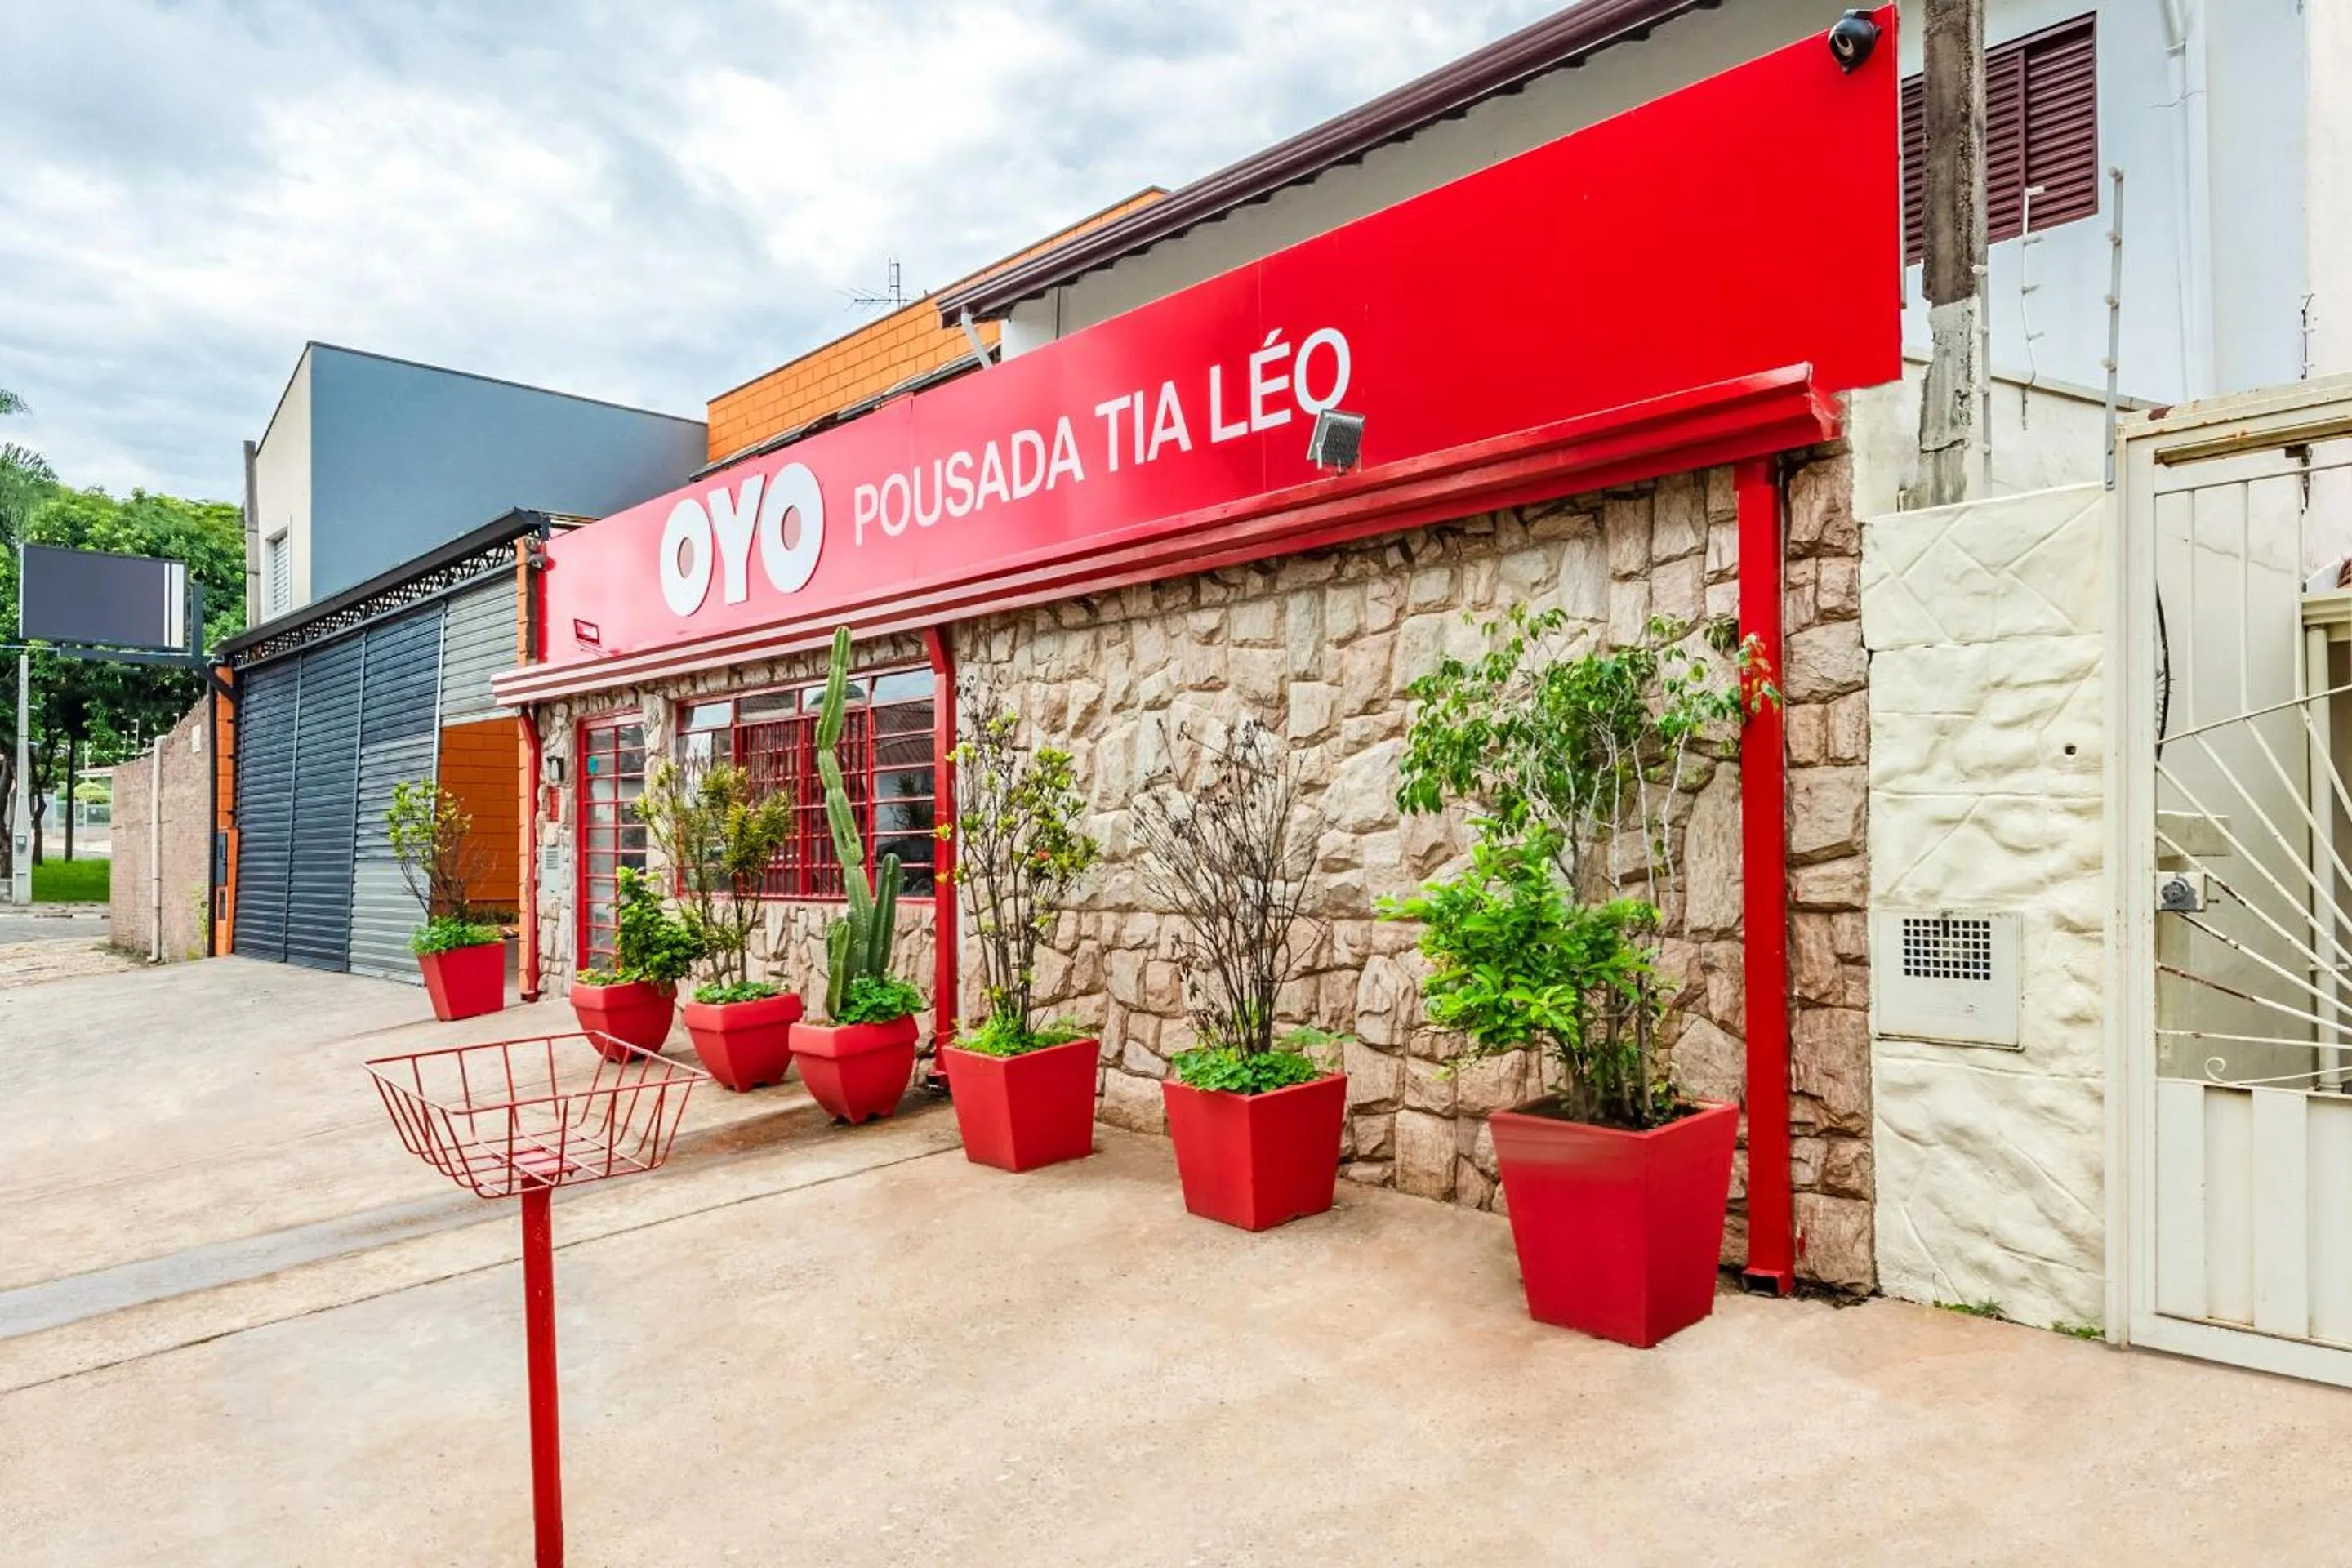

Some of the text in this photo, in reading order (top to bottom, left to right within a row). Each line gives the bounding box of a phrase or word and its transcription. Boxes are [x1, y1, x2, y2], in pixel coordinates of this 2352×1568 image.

[660, 327, 1352, 617] OYO POUSADA TIA LÉO
